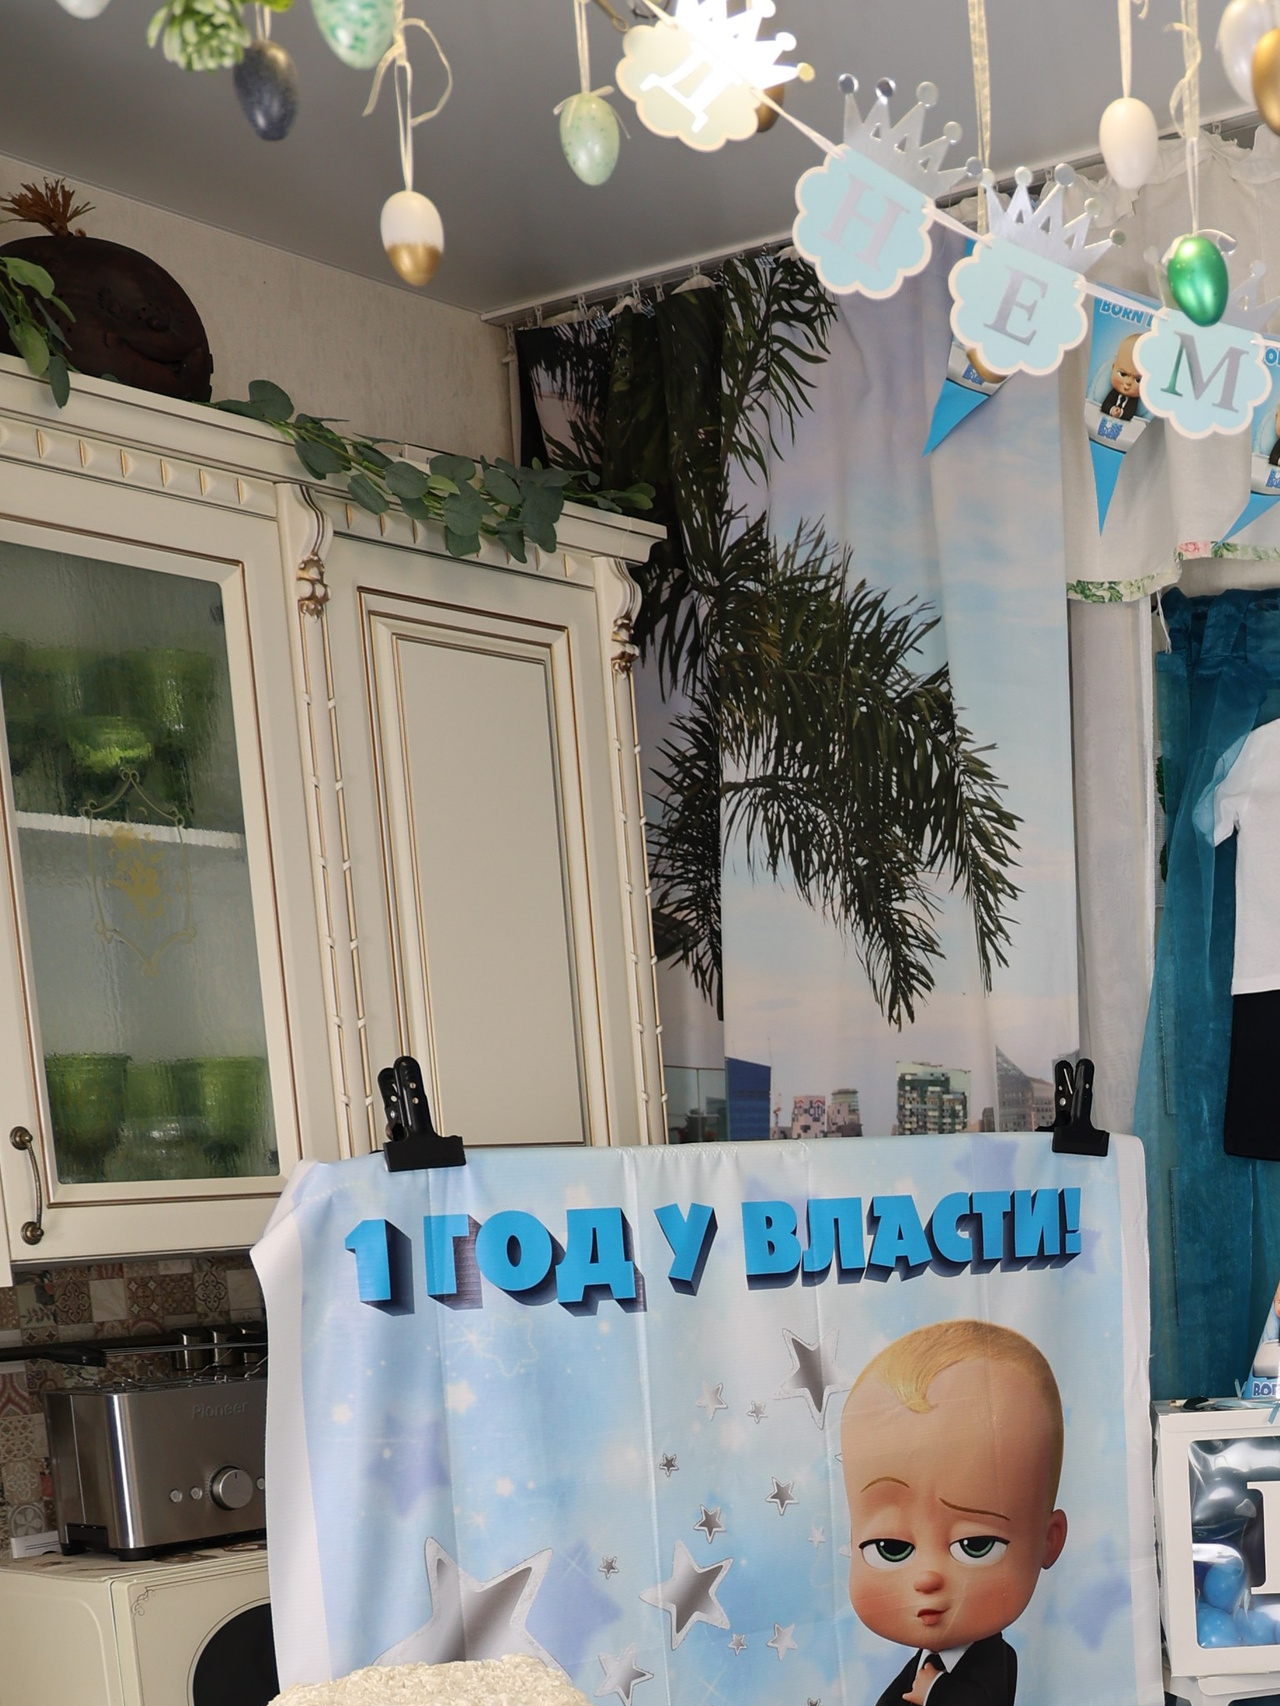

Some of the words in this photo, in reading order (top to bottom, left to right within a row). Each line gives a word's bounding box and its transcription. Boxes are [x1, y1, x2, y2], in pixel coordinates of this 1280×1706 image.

[1100, 300, 1144, 325] BORN
[345, 1217, 408, 1311] 1
[422, 1205, 644, 1312] ГОД
[653, 1201, 718, 1292] У
[741, 1187, 1082, 1287] ВЛАСТИ!
[191, 1401, 248, 1420] Pioneer
